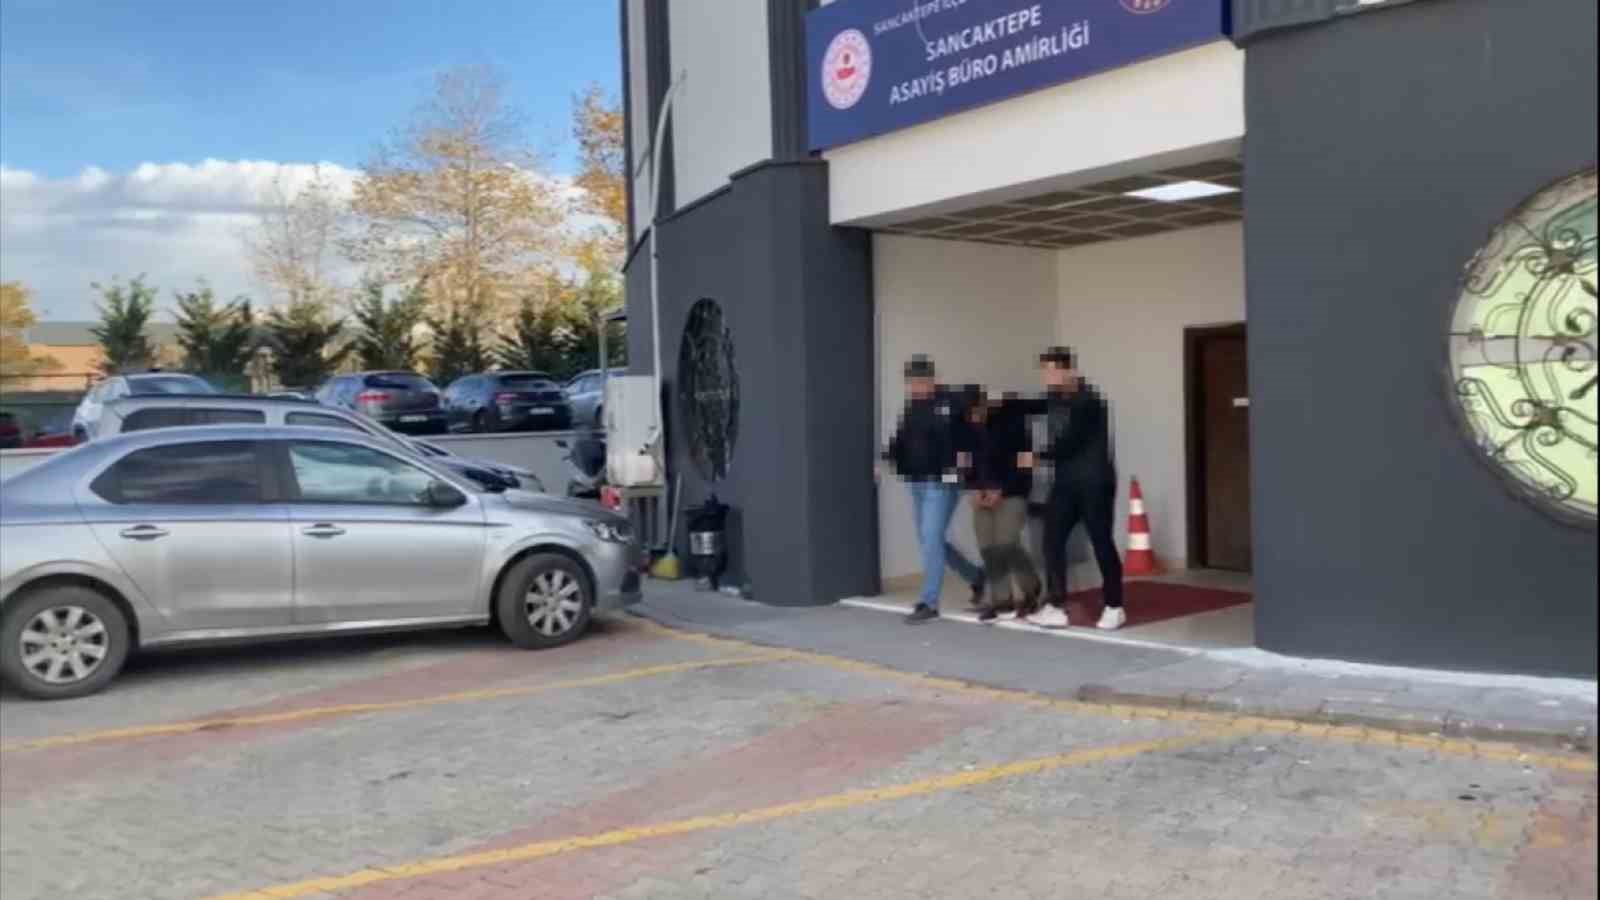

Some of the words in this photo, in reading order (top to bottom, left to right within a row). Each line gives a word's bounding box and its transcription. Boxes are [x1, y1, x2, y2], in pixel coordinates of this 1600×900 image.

[890, 70, 945, 104] ASAYİŞ
[949, 54, 998, 87] BÜRO
[1001, 20, 1090, 71] AMİRLİĞİ
[926, 5, 1042, 61] SANCAKTEPE
